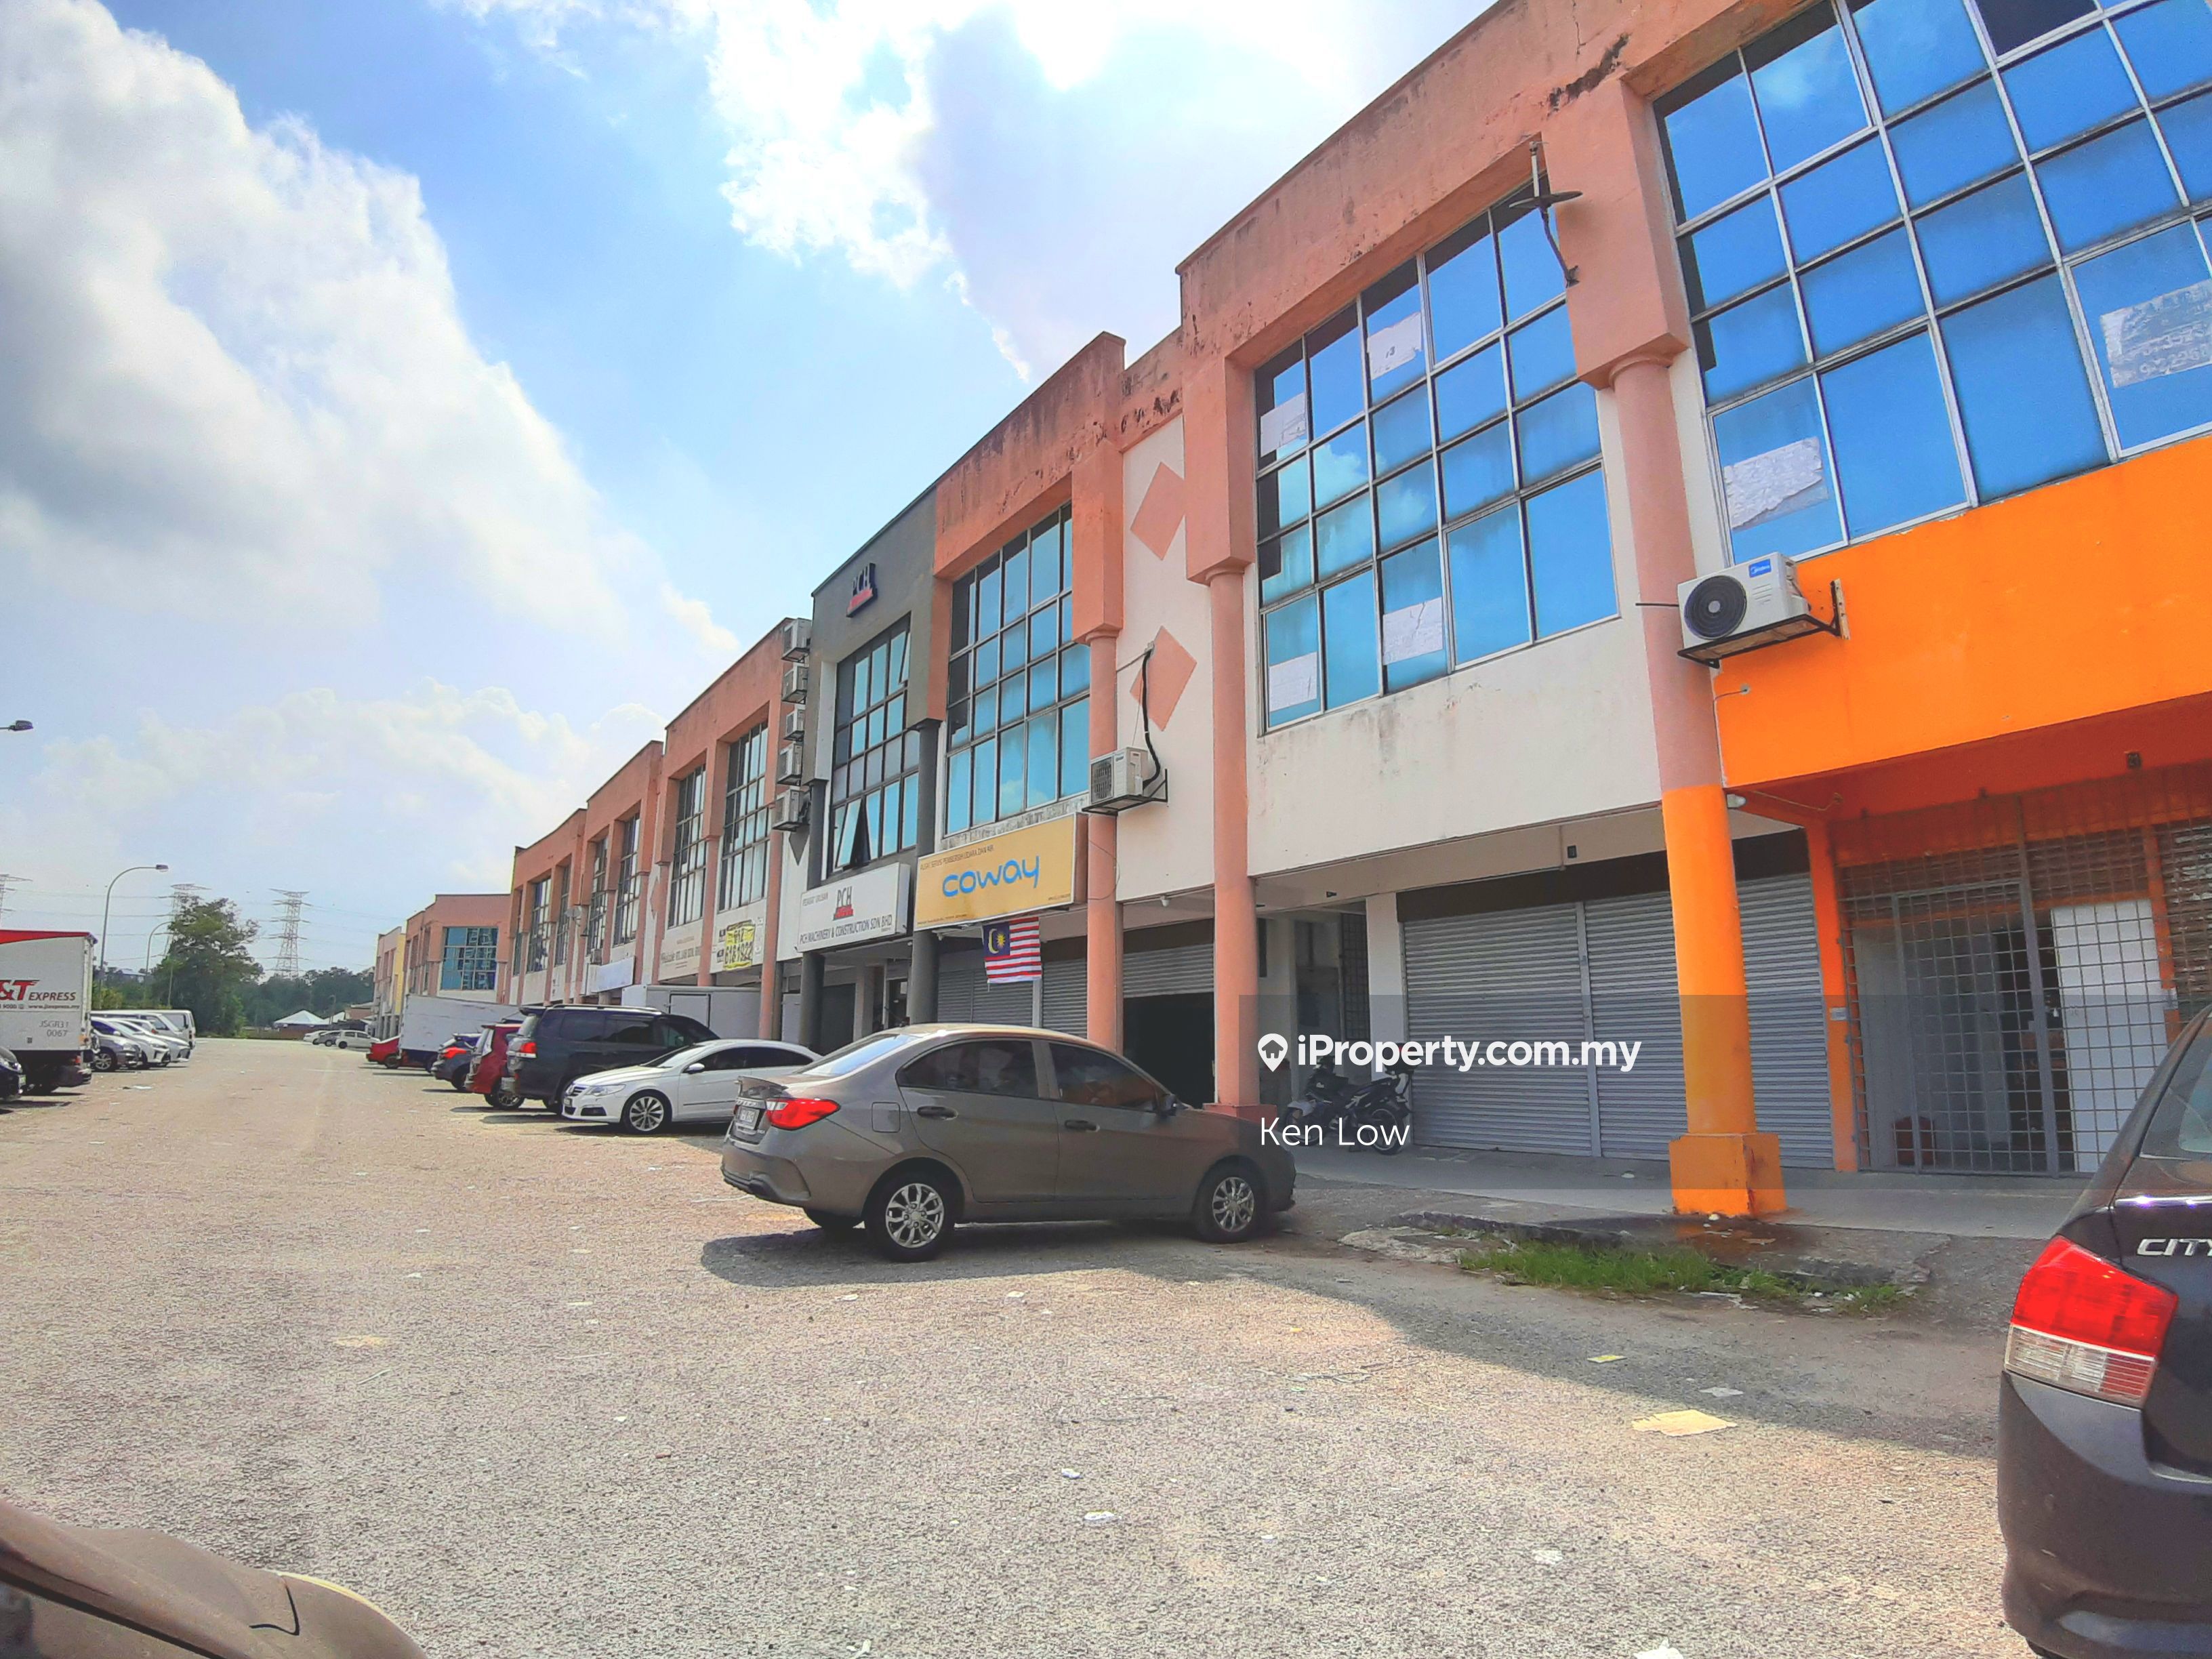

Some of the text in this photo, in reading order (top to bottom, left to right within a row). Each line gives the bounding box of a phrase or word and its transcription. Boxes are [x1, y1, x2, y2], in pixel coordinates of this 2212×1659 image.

[852, 564, 871, 596] PCH
[977, 846, 987, 855] DAN
[943, 856, 1040, 897] coway
[837, 886, 853, 907] PCH
[800, 933, 808, 945] PCH
[808, 928, 831, 942] MACHINERY
[836, 919, 870, 937] CONSTRUCTION
[870, 917, 880, 930] SDN
[881, 914, 893, 927] BHD
[28, 992, 77, 1001] EXPRESS
